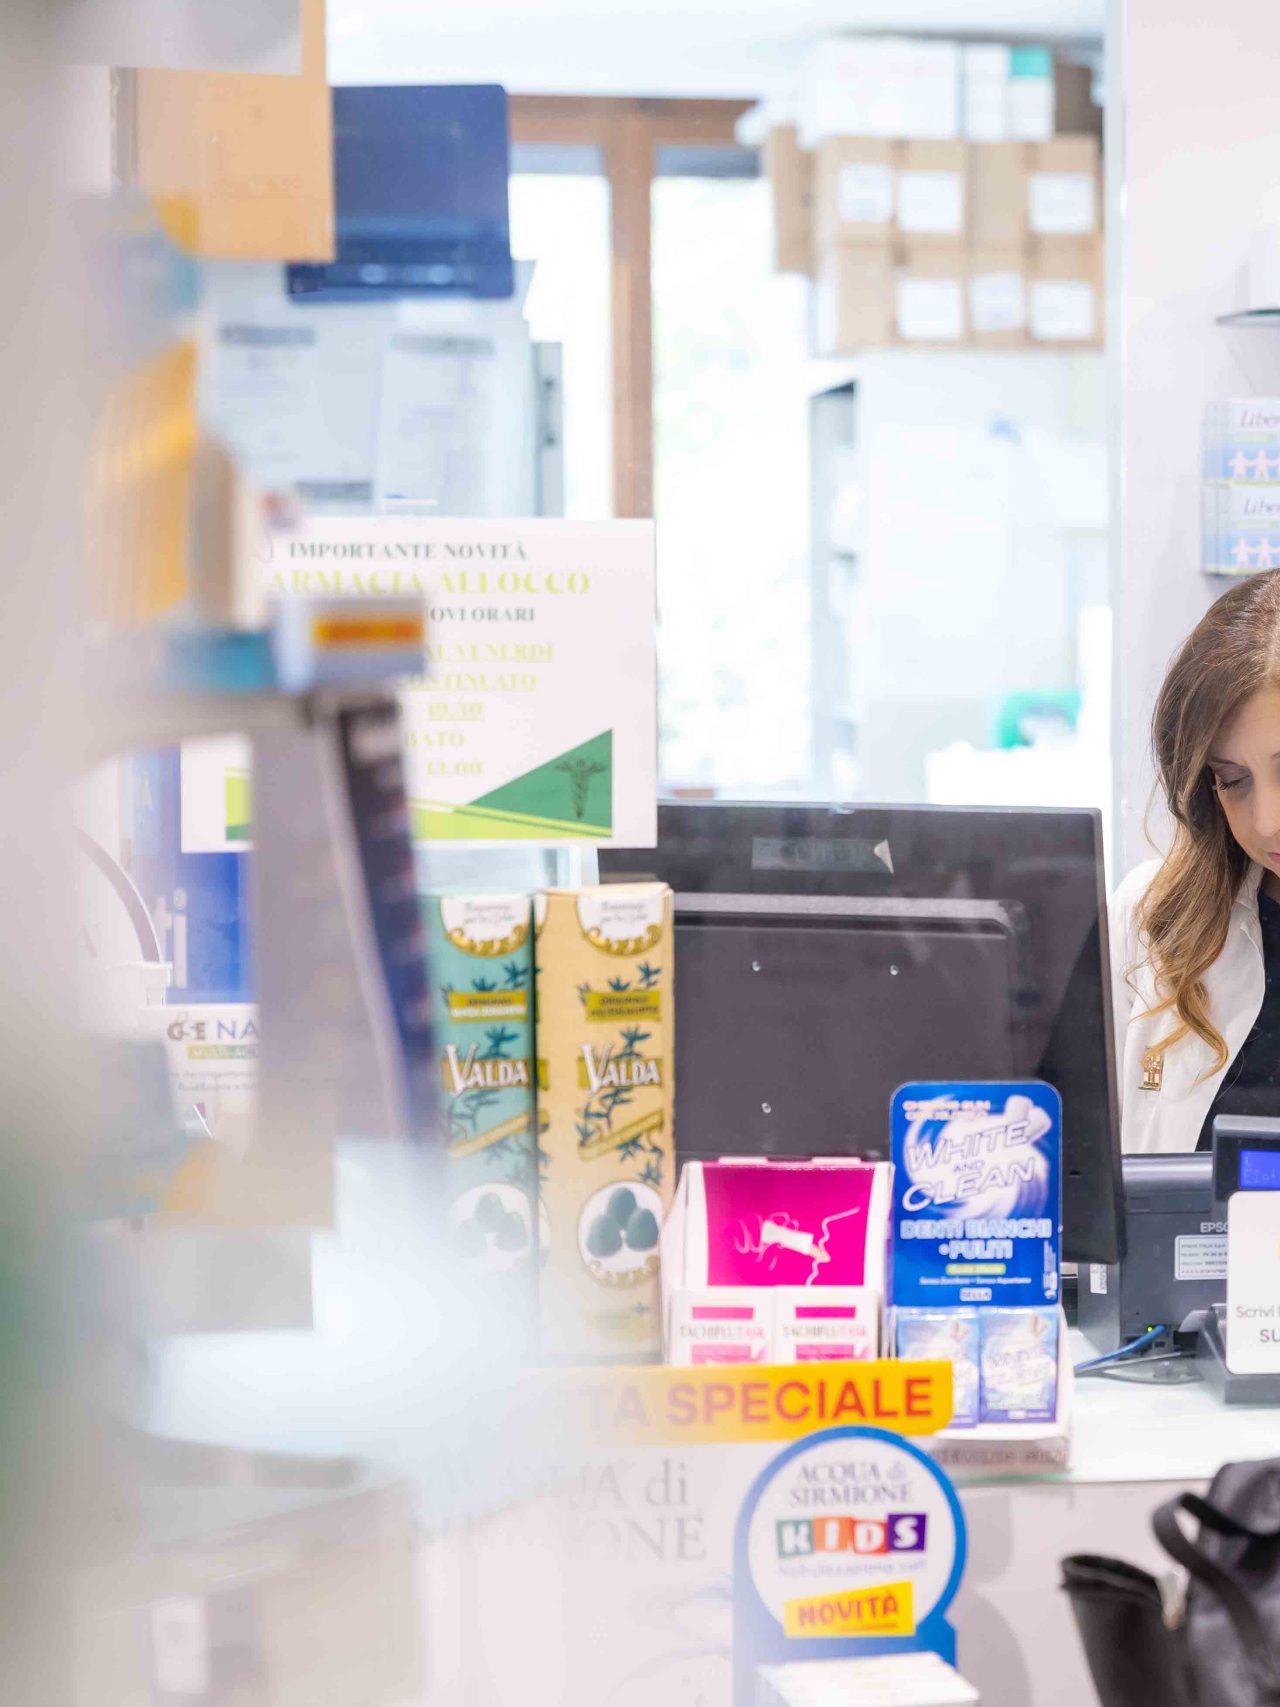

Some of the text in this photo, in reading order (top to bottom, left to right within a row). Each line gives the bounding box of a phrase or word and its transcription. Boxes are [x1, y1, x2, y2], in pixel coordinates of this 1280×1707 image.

[289, 541, 528, 560] IMPORTANTE NOVITÀ
[428, 607, 535, 622] OVI ORARI
[406, 732, 466, 747] BATO
[445, 1041, 529, 1098] VALDA
[579, 1041, 661, 1099] VALDA
[905, 1119, 1031, 1173] WHITE
[953, 1160, 985, 1173] AND
[902, 1157, 1036, 1212] CLEAN
[900, 1218, 1052, 1239] DENTI BIANCHI
[1235, 1305, 1275, 1318] Scrivi
[667, 1378, 933, 1426] SPECIALE
[778, 1515, 924, 1556] KIDS
[797, 1587, 900, 1628] NOVITÀ
